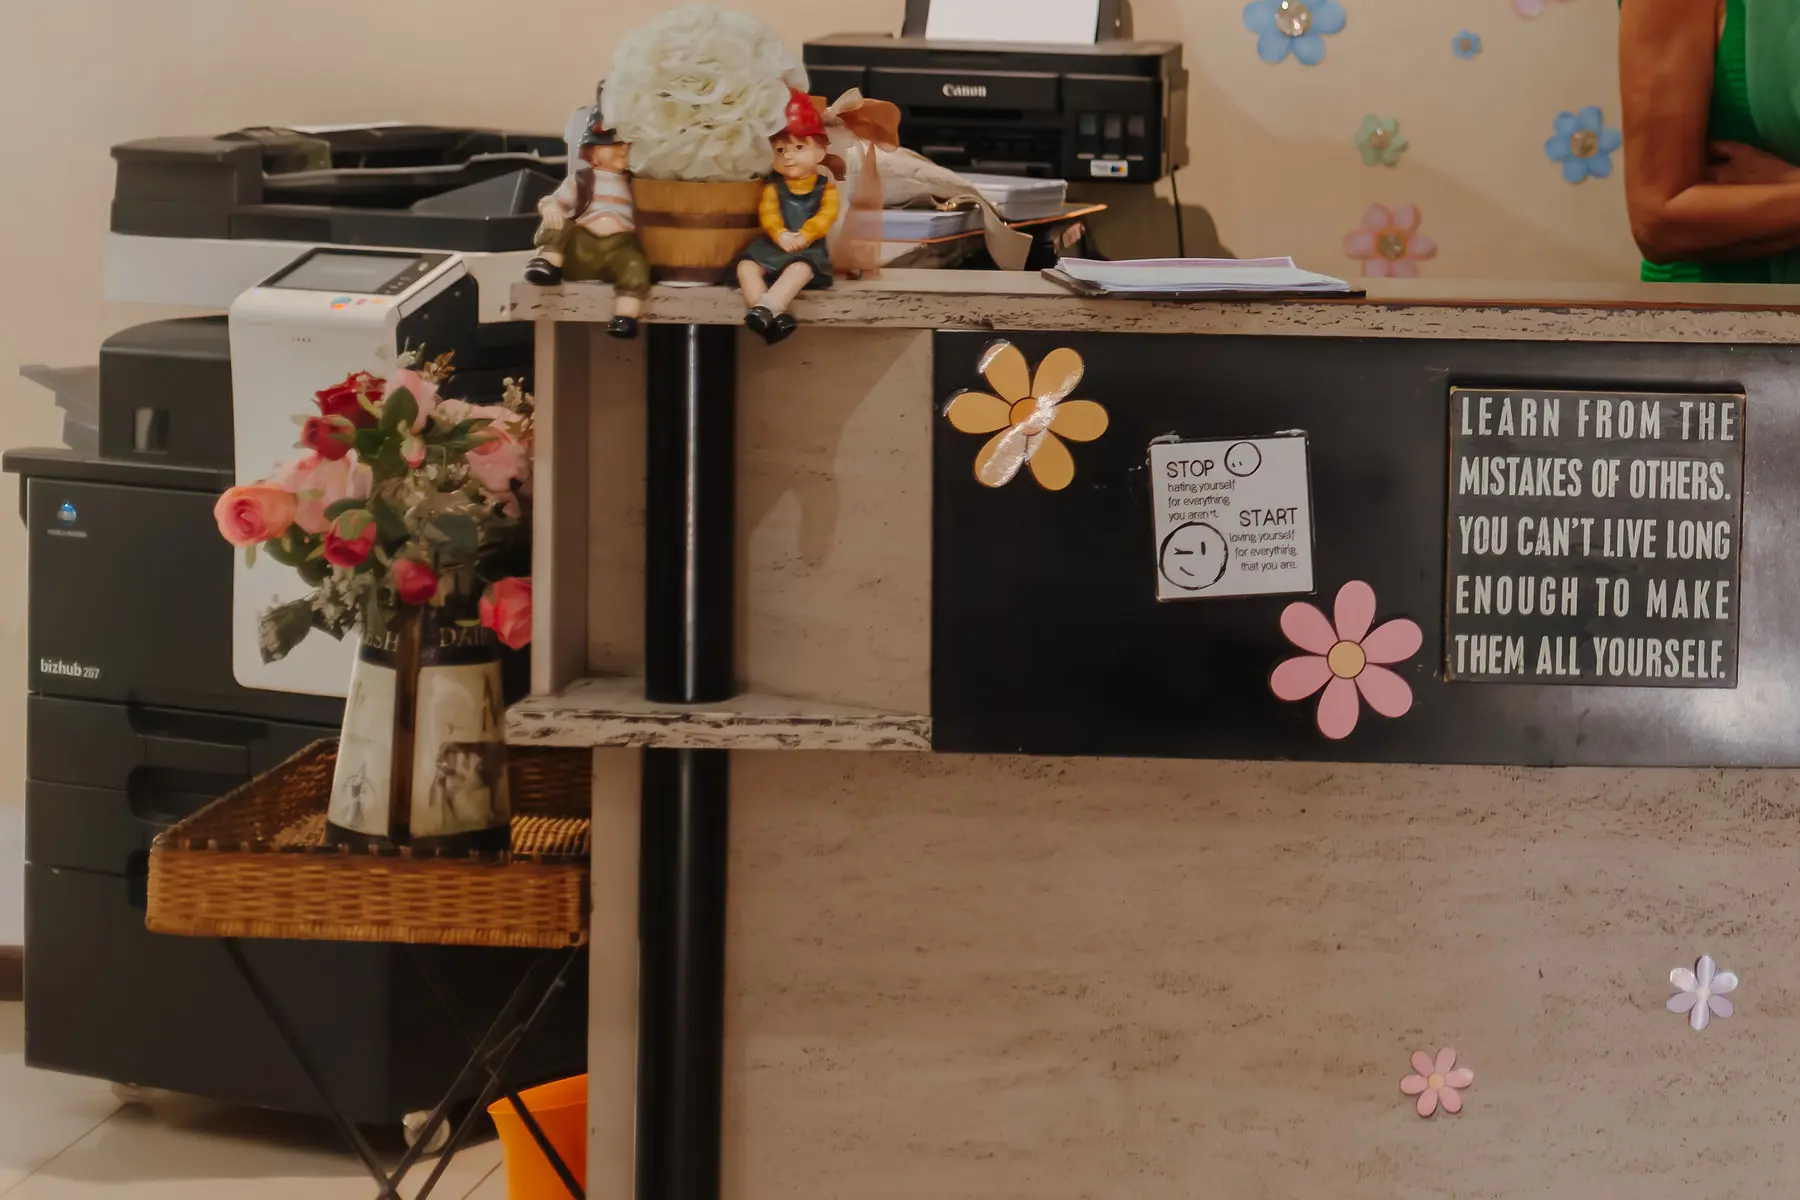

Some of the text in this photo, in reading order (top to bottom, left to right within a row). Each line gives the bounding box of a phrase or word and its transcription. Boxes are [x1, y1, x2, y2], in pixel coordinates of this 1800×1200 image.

[942, 83, 987, 98] Canon
[1461, 396, 1735, 441] LEARN FROM THE
[1166, 459, 1215, 478] STOP
[1458, 456, 1731, 500] MISTAKES OF OTHERS.
[1167, 479, 1235, 493] hating yourself
[1168, 495, 1231, 508] for everything
[1168, 511, 1186, 523] you
[1239, 507, 1298, 527] START
[1229, 529, 1295, 544] loving yourself
[1458, 515, 1731, 560] YOU CAN'T LIVE LONG
[1235, 544, 1297, 559] for everything
[1240, 561, 1258, 571] that
[1261, 562, 1278, 573] you
[1455, 575, 1730, 620] ENOUGH TO MAKE
[1454, 634, 1726, 679] THEM ALL YOURSELF.
[40, 658, 82, 677] bizhub
